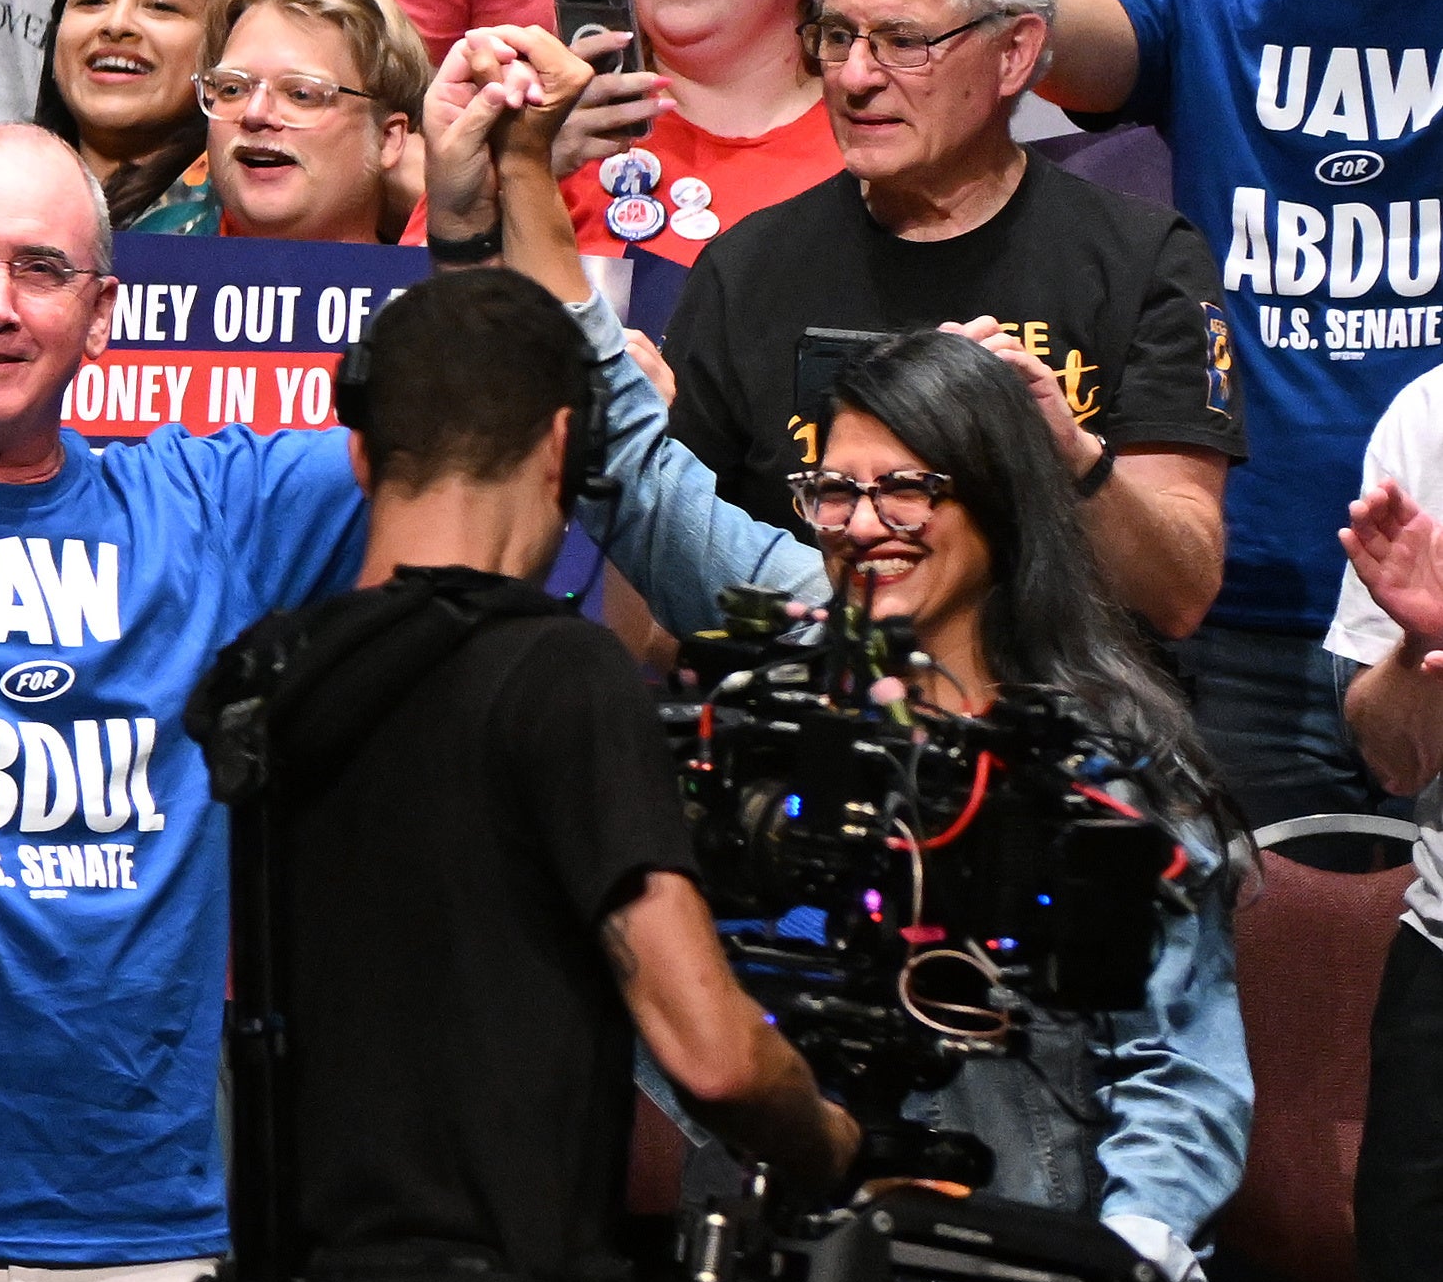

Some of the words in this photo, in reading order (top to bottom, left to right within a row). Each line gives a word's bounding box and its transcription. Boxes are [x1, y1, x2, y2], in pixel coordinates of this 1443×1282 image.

[1257, 44, 1443, 141] UAW
[1330, 158, 1369, 180] FOR
[1224, 187, 1443, 298] ABDU
[111, 284, 197, 341] NEY
[213, 286, 301, 343] OUT
[317, 288, 372, 344] OF
[1261, 307, 1320, 350] U.S.
[1324, 306, 1443, 350] SENATE
[208, 366, 257, 423] IN
[15, 672, 58, 692] FOR
[21, 843, 138, 890] SENATE
